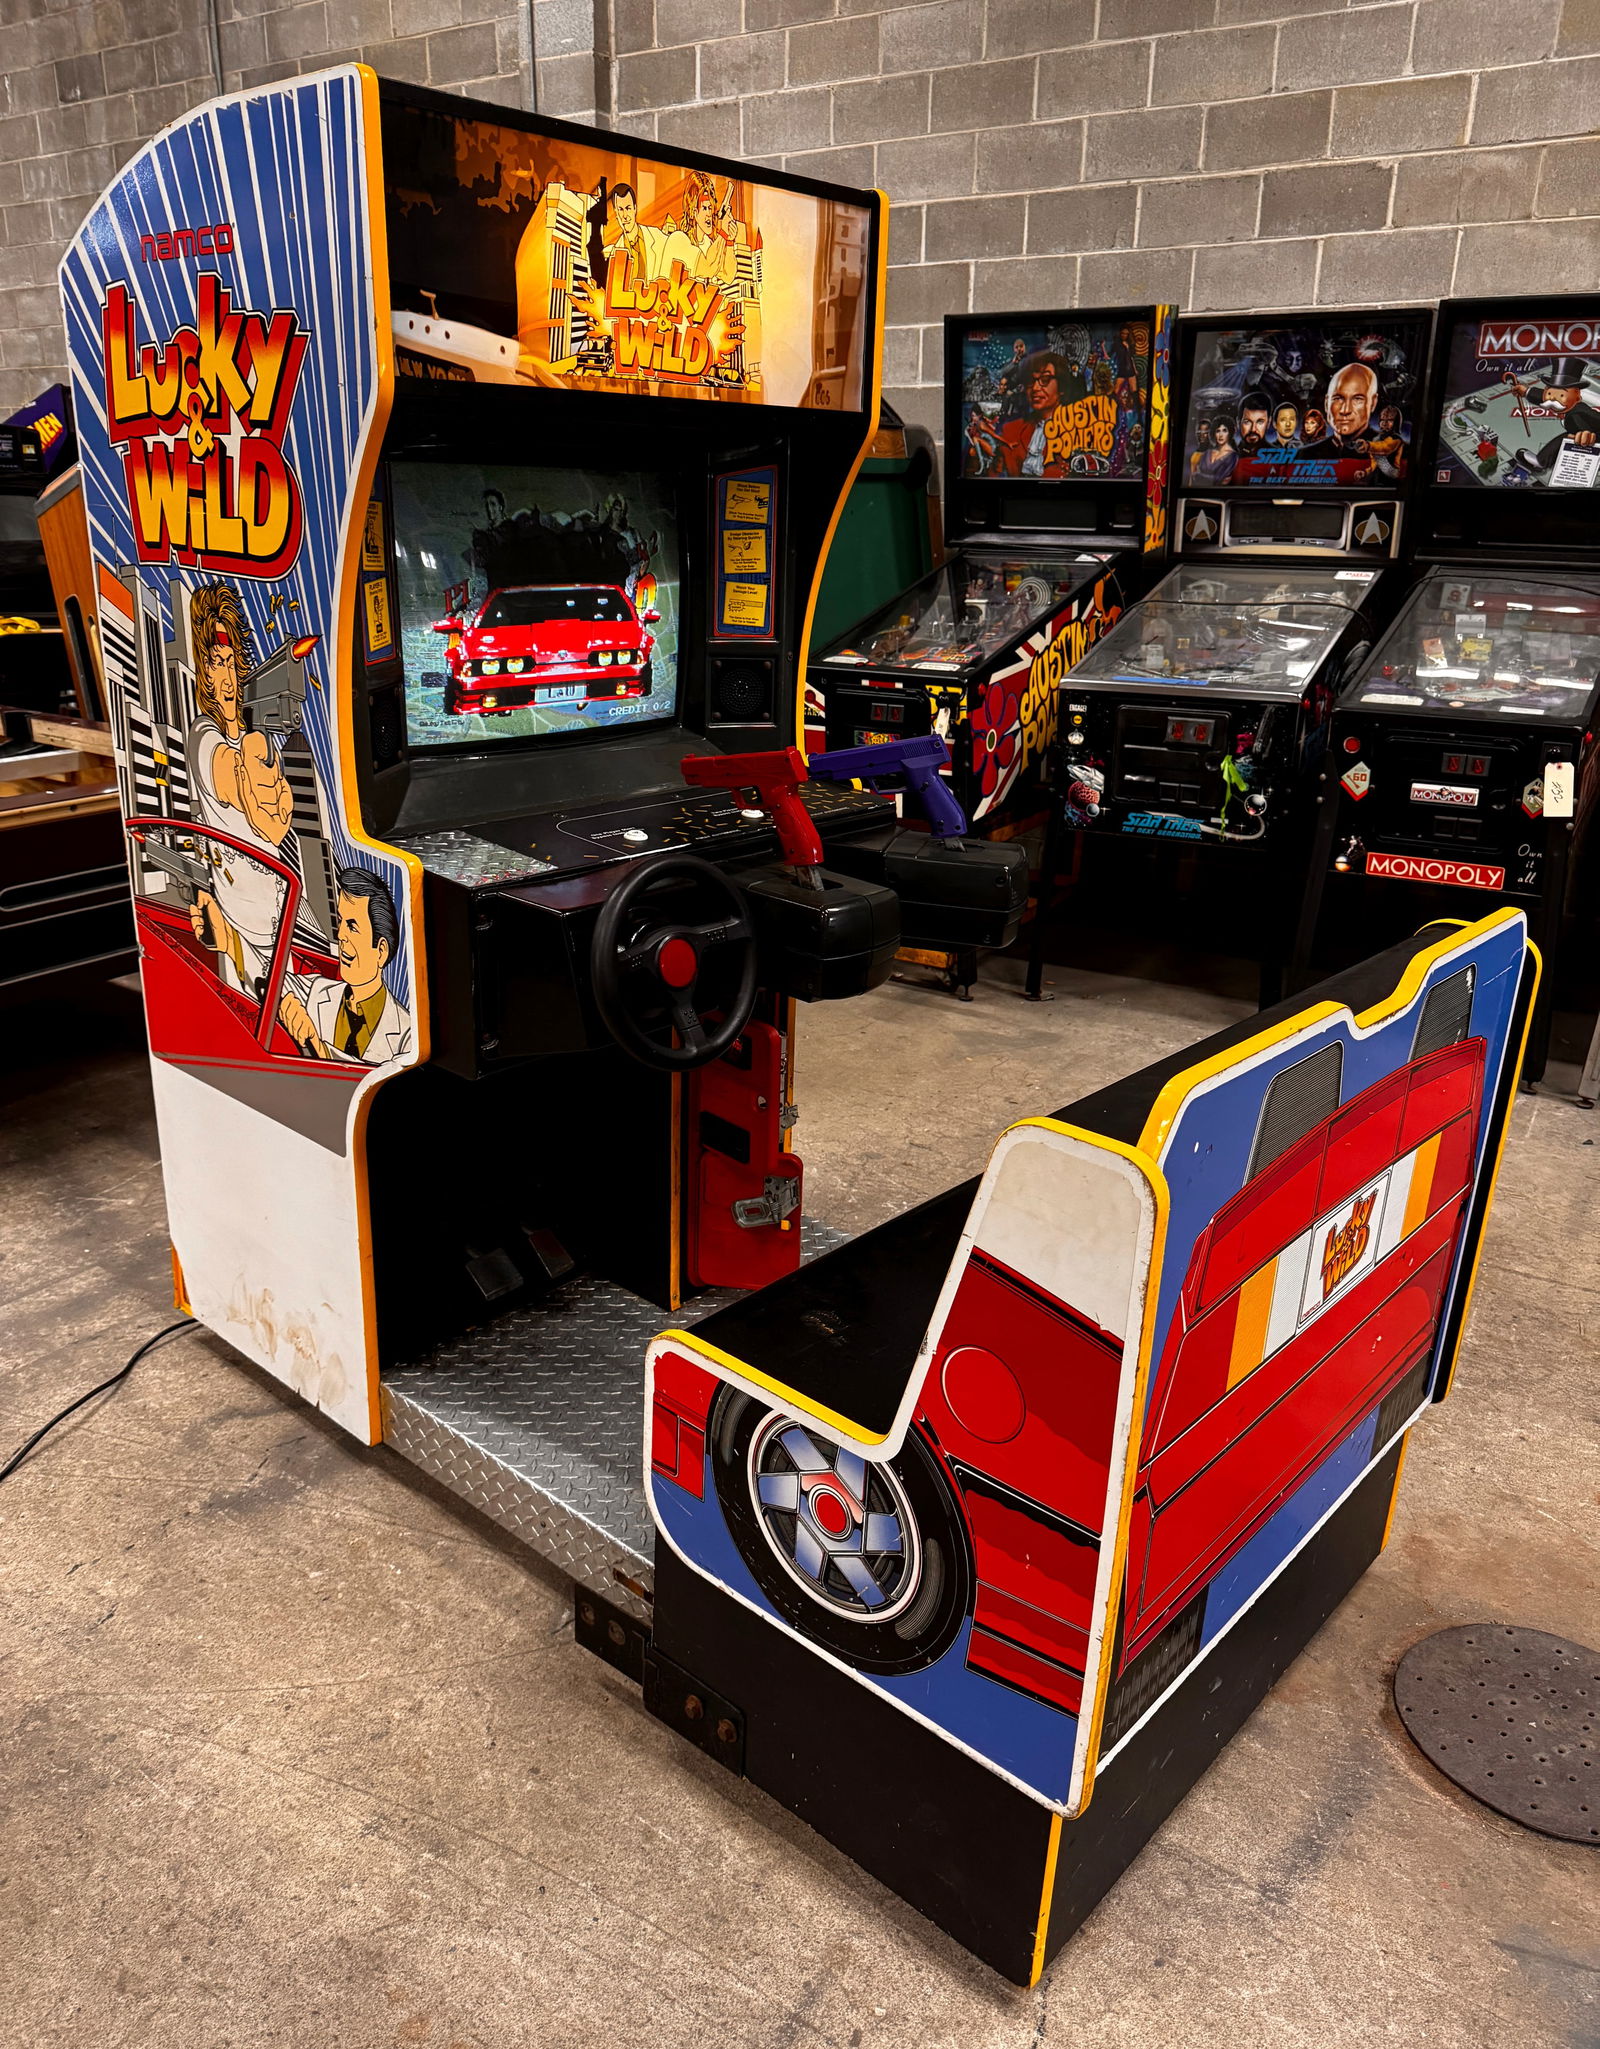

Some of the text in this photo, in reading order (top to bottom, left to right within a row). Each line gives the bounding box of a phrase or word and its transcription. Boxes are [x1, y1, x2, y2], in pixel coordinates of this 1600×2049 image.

[140, 223, 234, 263] namco
[656, 303, 673, 332] &
[1516, 358, 1536, 373] all
[187, 380, 215, 460] &
[1044, 395, 1118, 440] AUSTIN
[1044, 421, 1114, 465] POWERS
[1251, 448, 1298, 464] STAR
[1293, 460, 1339, 476] TREK
[1020, 621, 1088, 725] AUSTIN
[609, 700, 672, 717] CREDIT 0/2
[1353, 772, 1367, 782] 60
[1413, 790, 1474, 804] MONOPOLY
[1122, 812, 1205, 832] STAR TREK
[1517, 843, 1543, 859] Own
[1369, 856, 1502, 886] MONOPOLY
[1525, 860, 1534, 869] it
[1516, 872, 1535, 885] all
